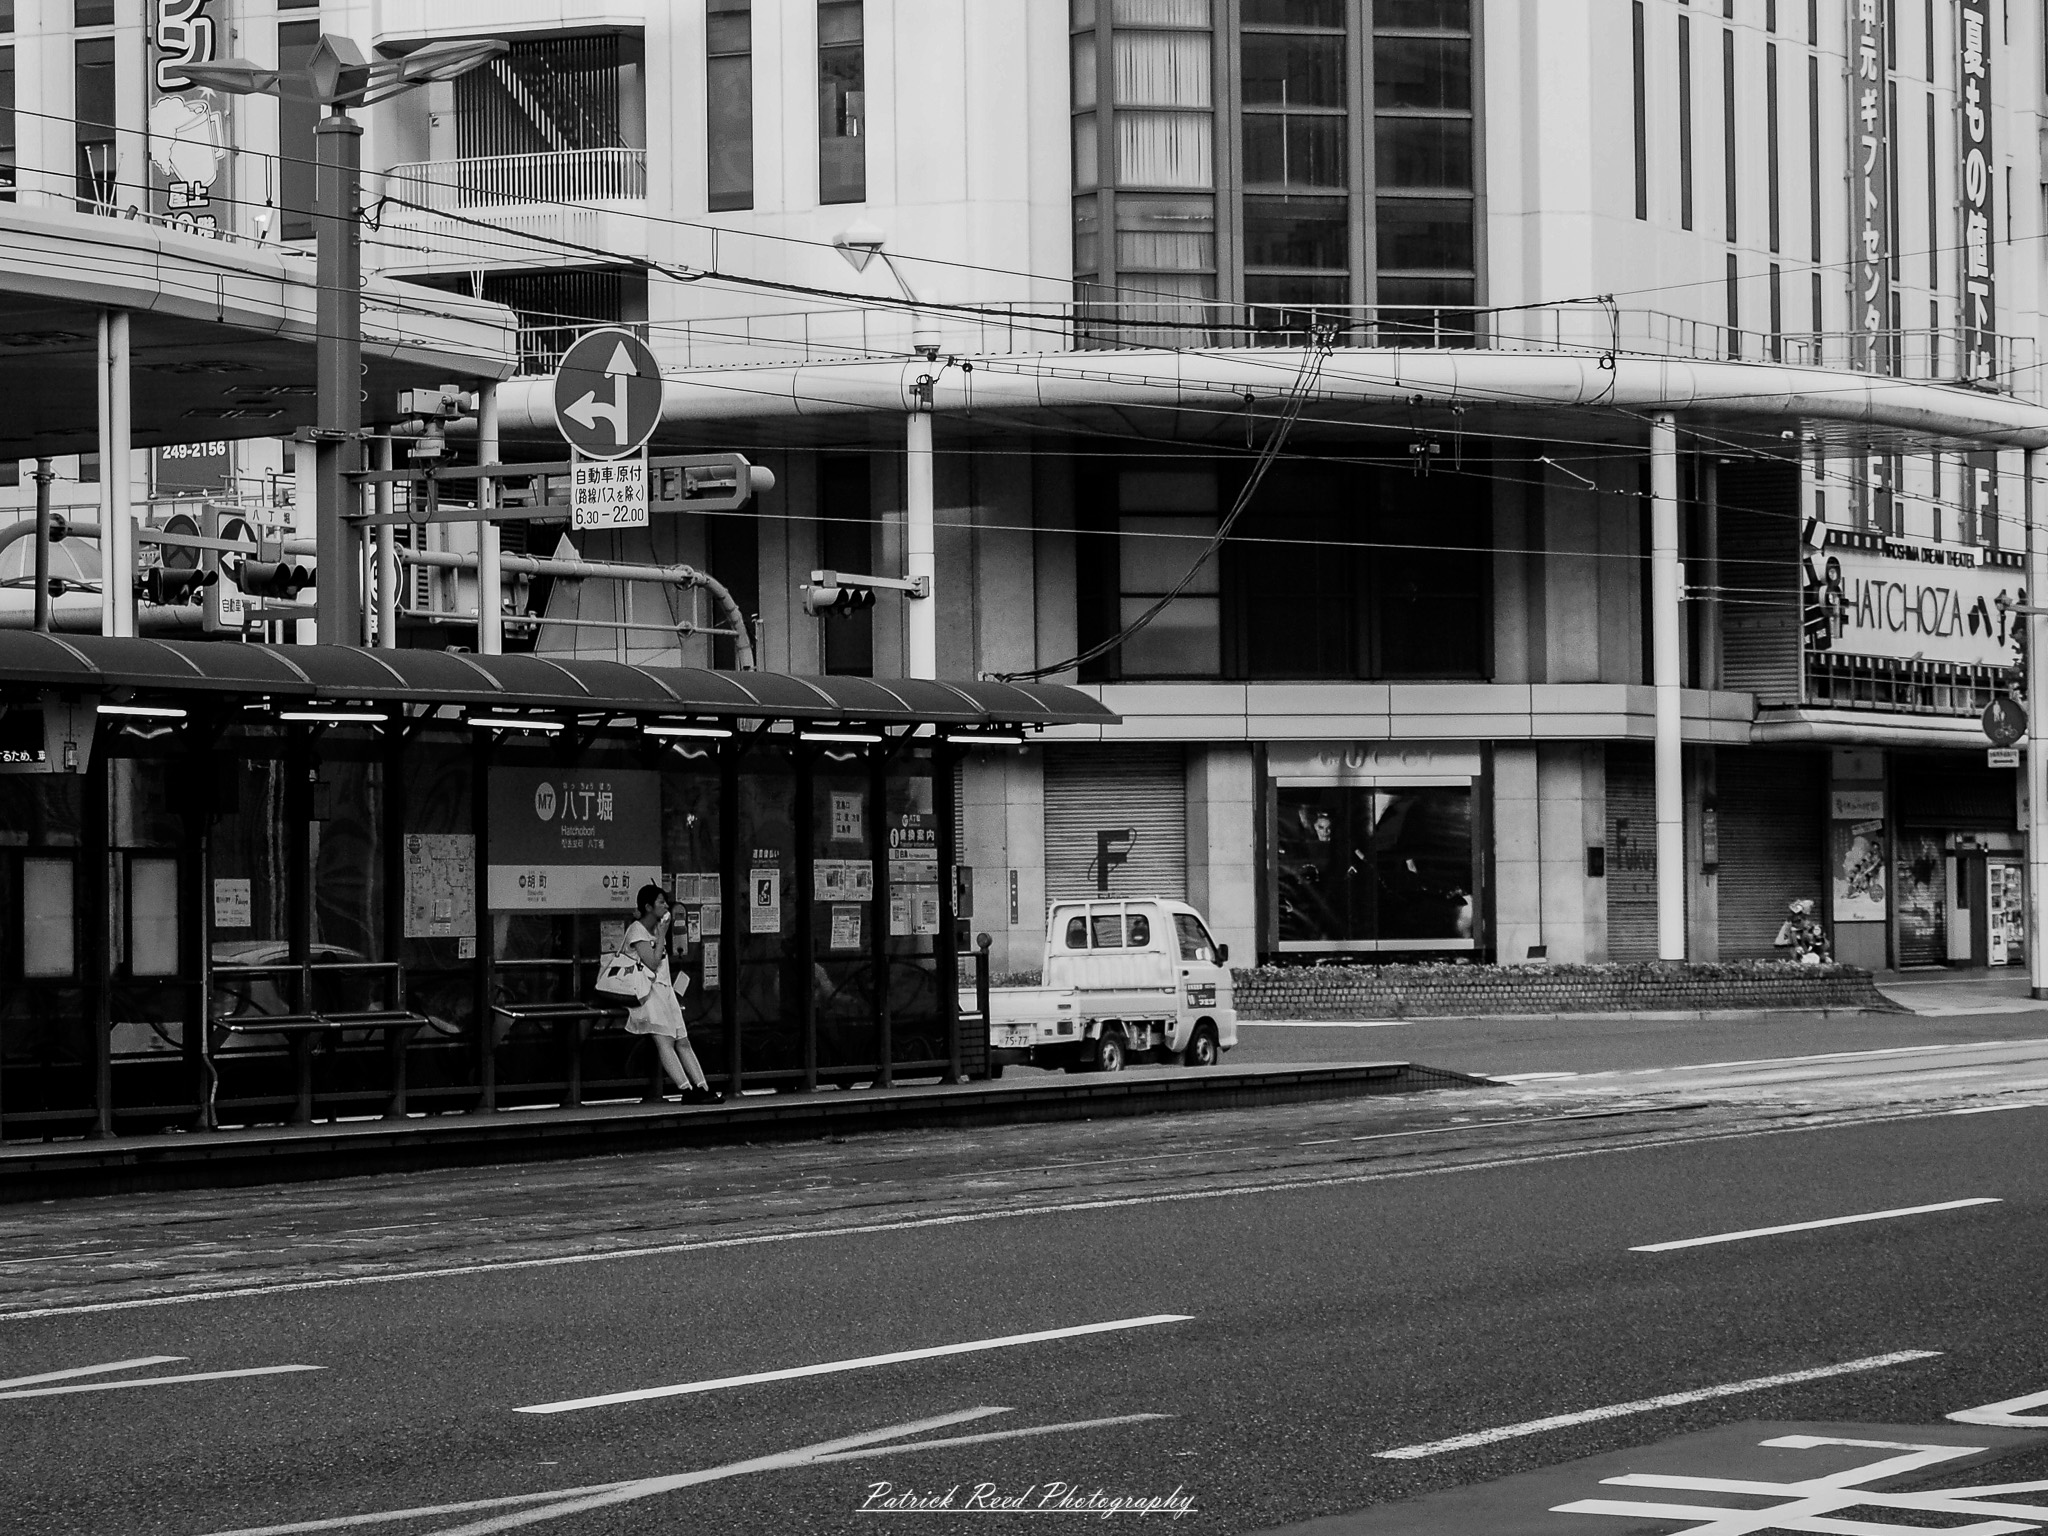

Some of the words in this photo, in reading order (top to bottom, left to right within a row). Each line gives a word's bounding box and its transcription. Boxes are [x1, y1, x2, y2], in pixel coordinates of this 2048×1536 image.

[162, 441, 226, 459] 249-2156
[1842, 576, 1964, 637] HATCHOZA
[538, 793, 553, 810] M7
[561, 791, 613, 822] 八丁堀
